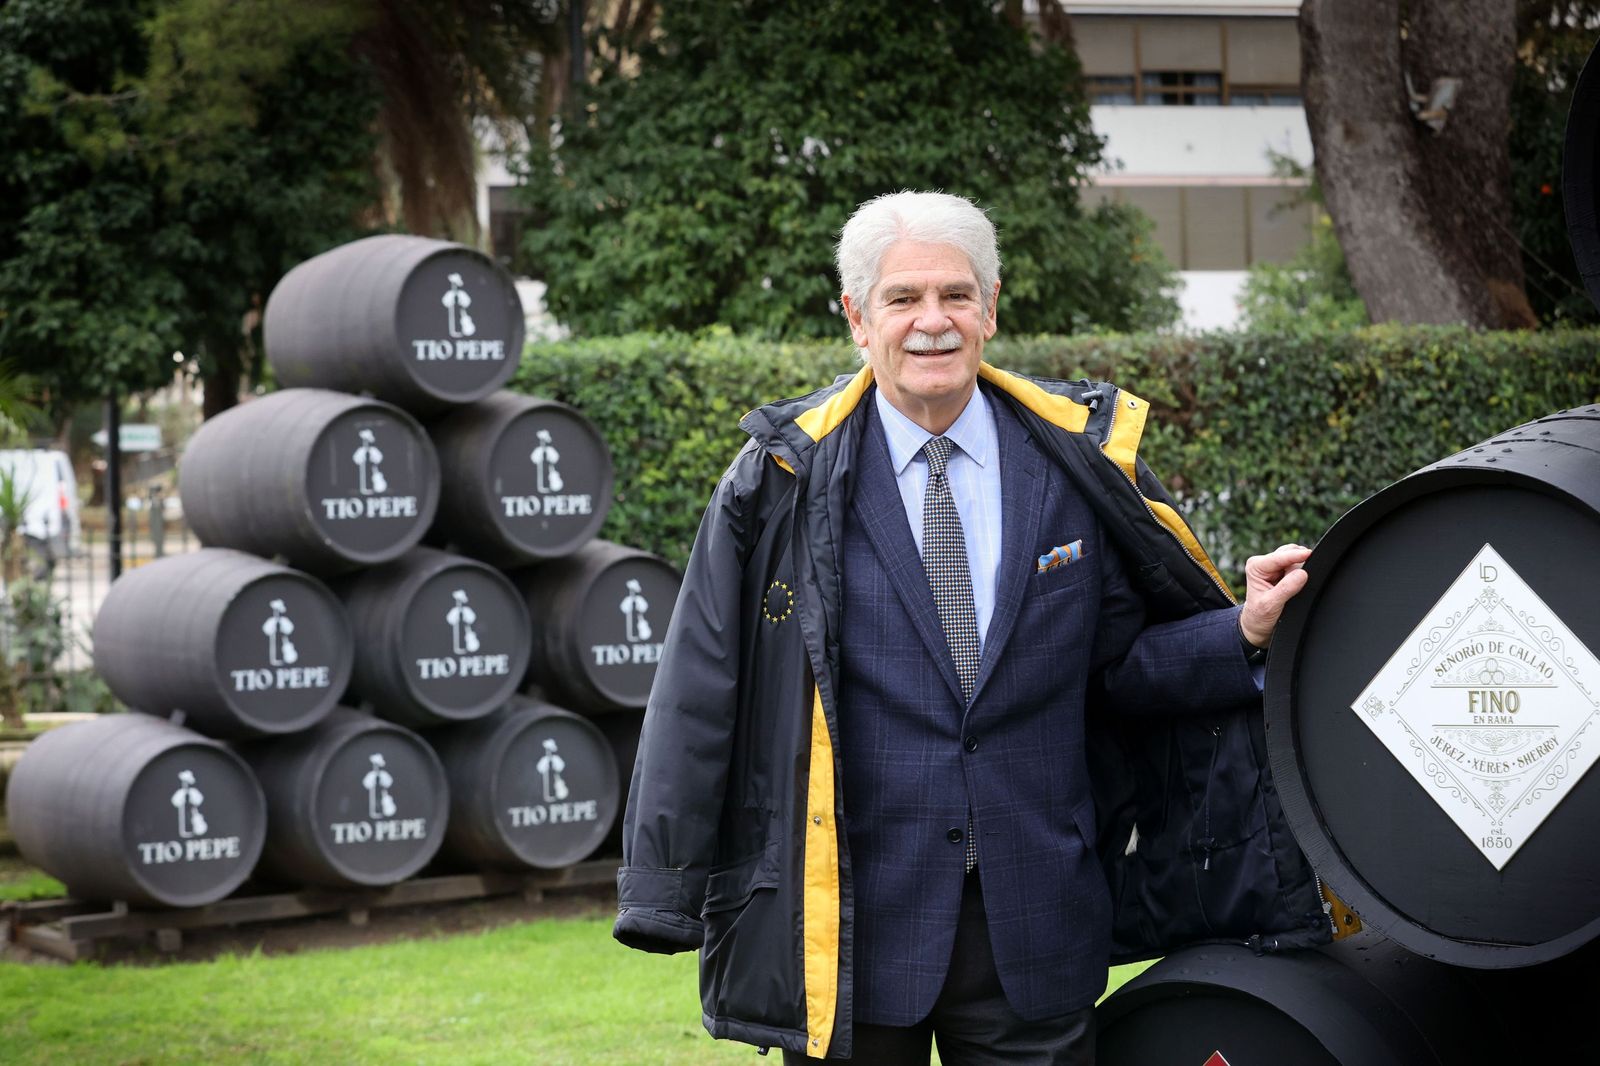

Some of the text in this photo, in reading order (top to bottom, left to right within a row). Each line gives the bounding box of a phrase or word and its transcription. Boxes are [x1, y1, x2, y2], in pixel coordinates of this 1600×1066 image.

[411, 339, 505, 361] TIO PEPE
[321, 495, 418, 520] TIO PEPE
[500, 494, 592, 518] TIO PEPE
[415, 653, 509, 680] TIO PEPE
[591, 643, 631, 666] TIO
[1488, 640, 1505, 654] DE
[1508, 644, 1555, 679] CALLAO
[230, 666, 330, 692] TIO PEPE
[1468, 690, 1520, 714] FINO
[1473, 715, 1514, 725] EN RAMA
[1430, 735, 1466, 764] JEREZ
[1516, 734, 1560, 769] SHERRY
[507, 799, 598, 828] TIO PEPE
[330, 818, 427, 844] TIO PEPE
[1481, 836, 1513, 849] 1850
[138, 836, 241, 865] TIO PEPE
